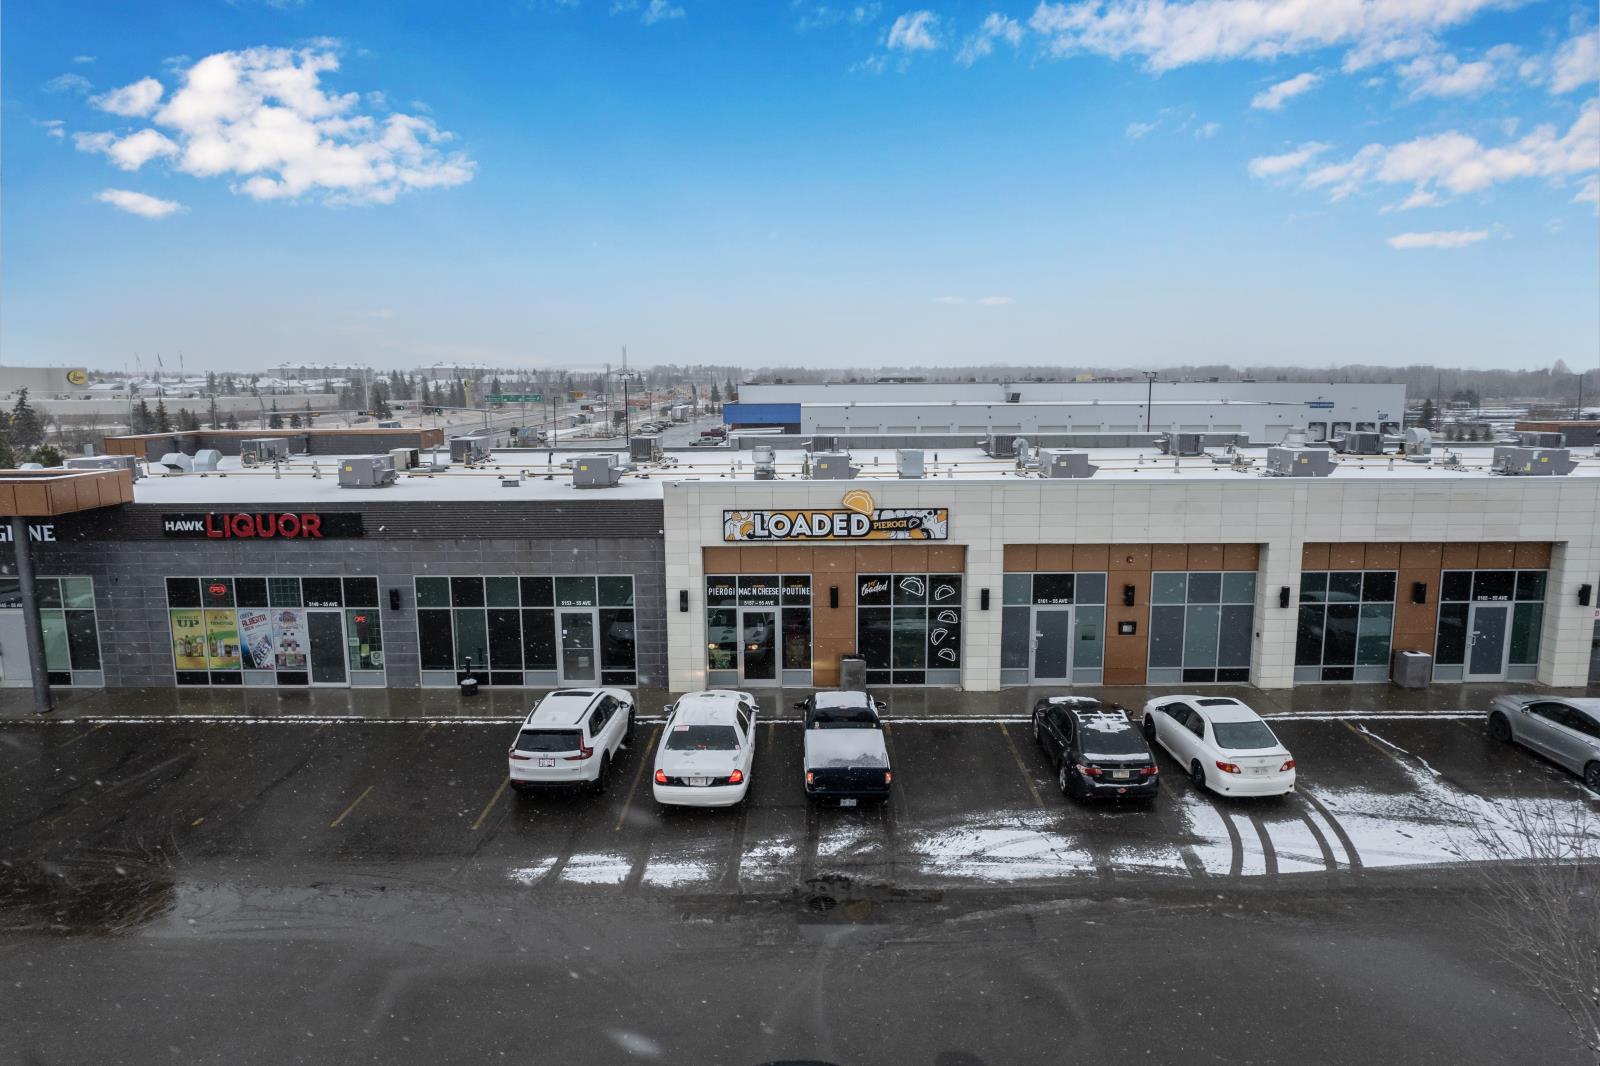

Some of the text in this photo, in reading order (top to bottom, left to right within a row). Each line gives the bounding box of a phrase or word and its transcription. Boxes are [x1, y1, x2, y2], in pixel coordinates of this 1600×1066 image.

[165, 512, 322, 539] HAWK LIQUOR
[753, 513, 907, 537] LOADED PIEROGI
[708, 587, 735, 596] PIEROGI
[738, 587, 779, 596] MAC N CHEESE
[782, 587, 810, 596] POUTINE
[861, 580, 888, 597] loaded
[176, 620, 200, 628] UP
[241, 614, 267, 628] ALBERTA
